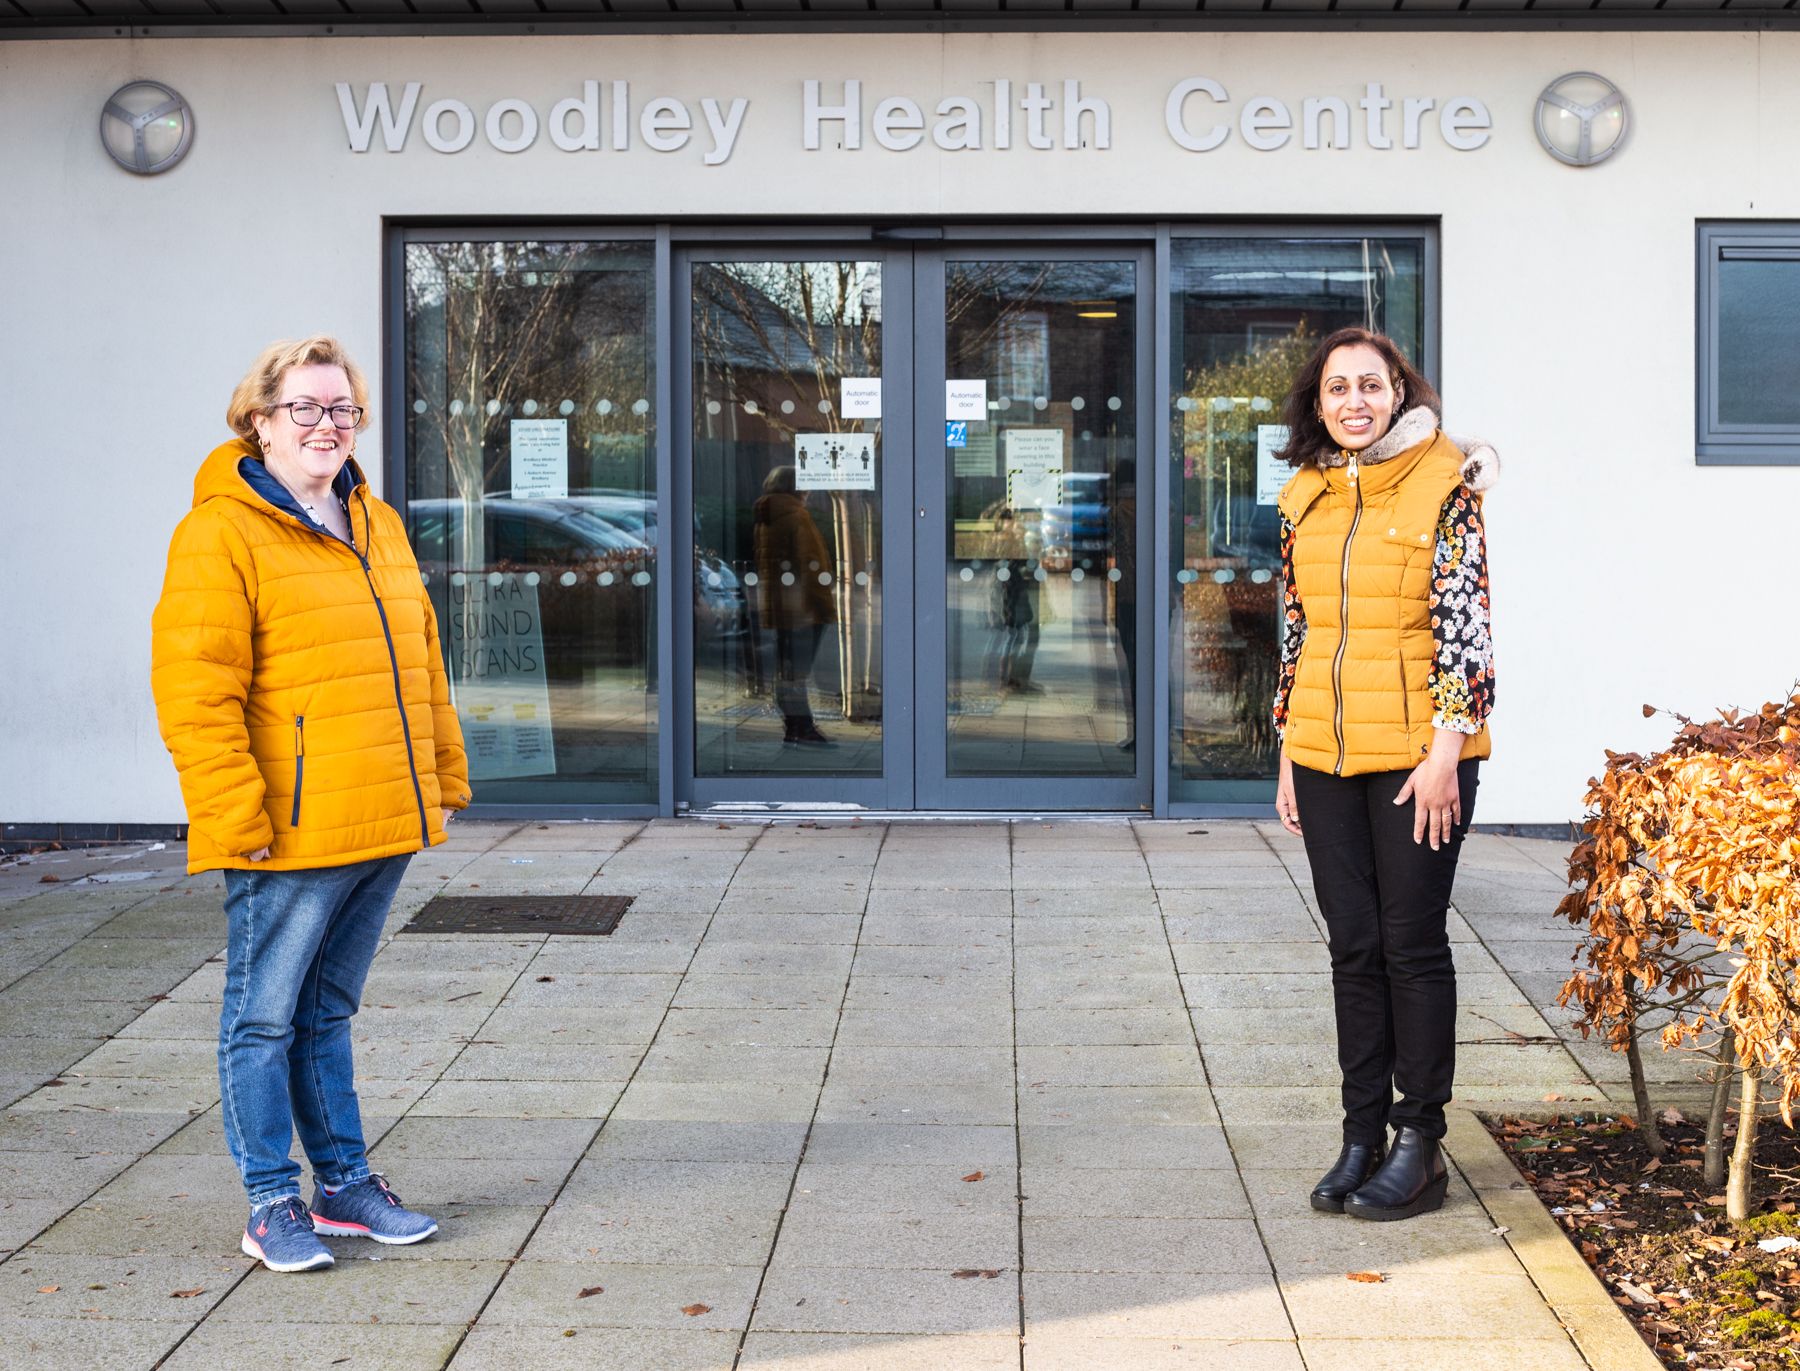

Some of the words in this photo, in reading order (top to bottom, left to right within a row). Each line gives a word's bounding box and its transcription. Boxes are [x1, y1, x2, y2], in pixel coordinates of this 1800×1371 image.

[335, 79, 750, 166] Woodley
[803, 78, 1112, 151] Health
[1165, 77, 1493, 152] Centre
[854, 398, 870, 406] door
[958, 400, 974, 408] door
[452, 578, 523, 605] ULTRA
[453, 610, 533, 641] SOUND
[459, 645, 537, 678] SCANS
